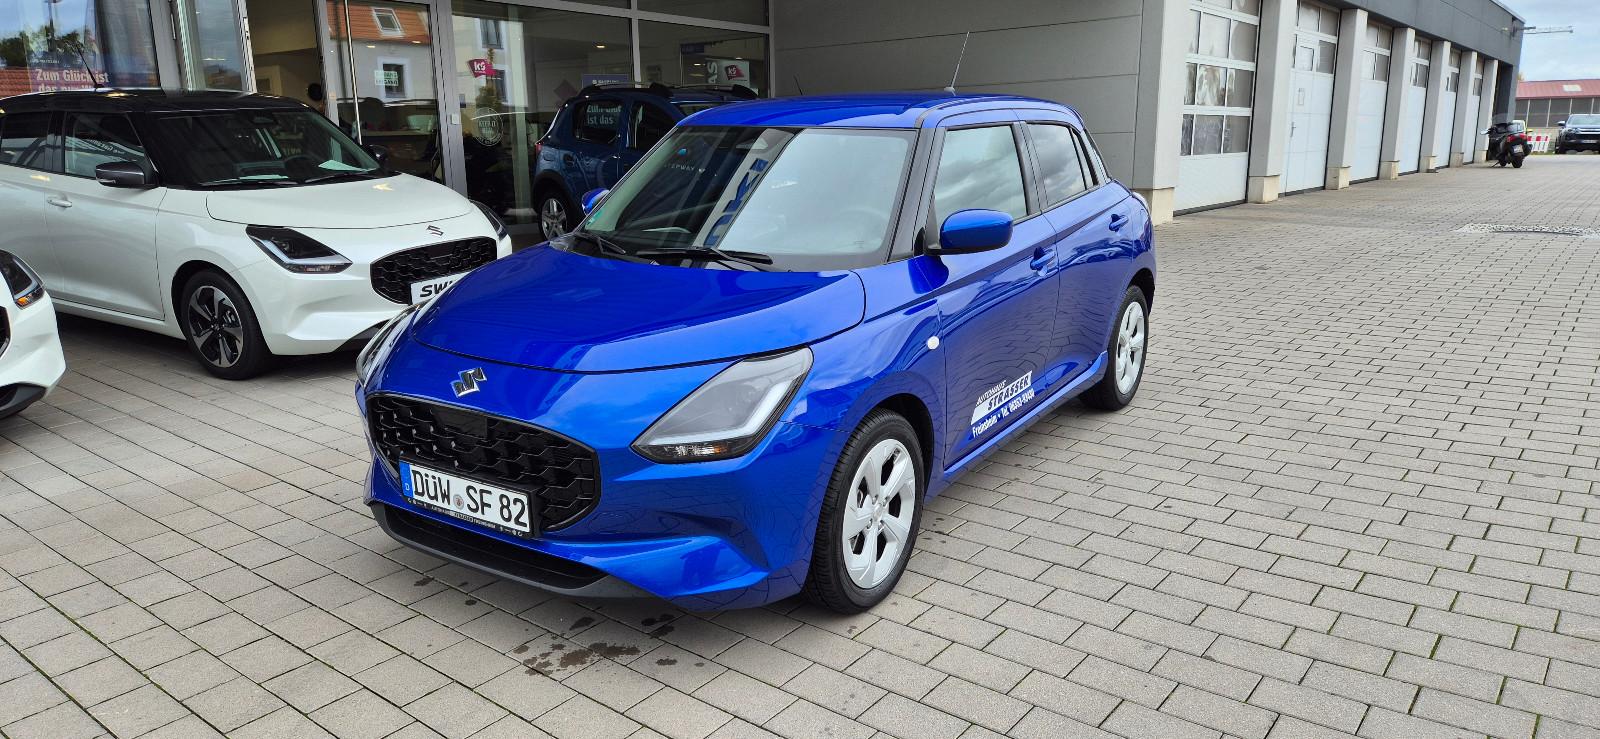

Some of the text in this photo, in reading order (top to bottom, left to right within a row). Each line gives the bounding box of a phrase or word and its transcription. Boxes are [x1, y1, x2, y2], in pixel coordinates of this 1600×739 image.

[35, 69, 109, 83] Zum Glück ist
[587, 114, 597, 125] ist
[988, 375, 1029, 411] STRASSER
[404, 482, 411, 491] D
[411, 469, 451, 506] DÜW
[465, 485, 493, 515] SF
[498, 493, 528, 528] 82
